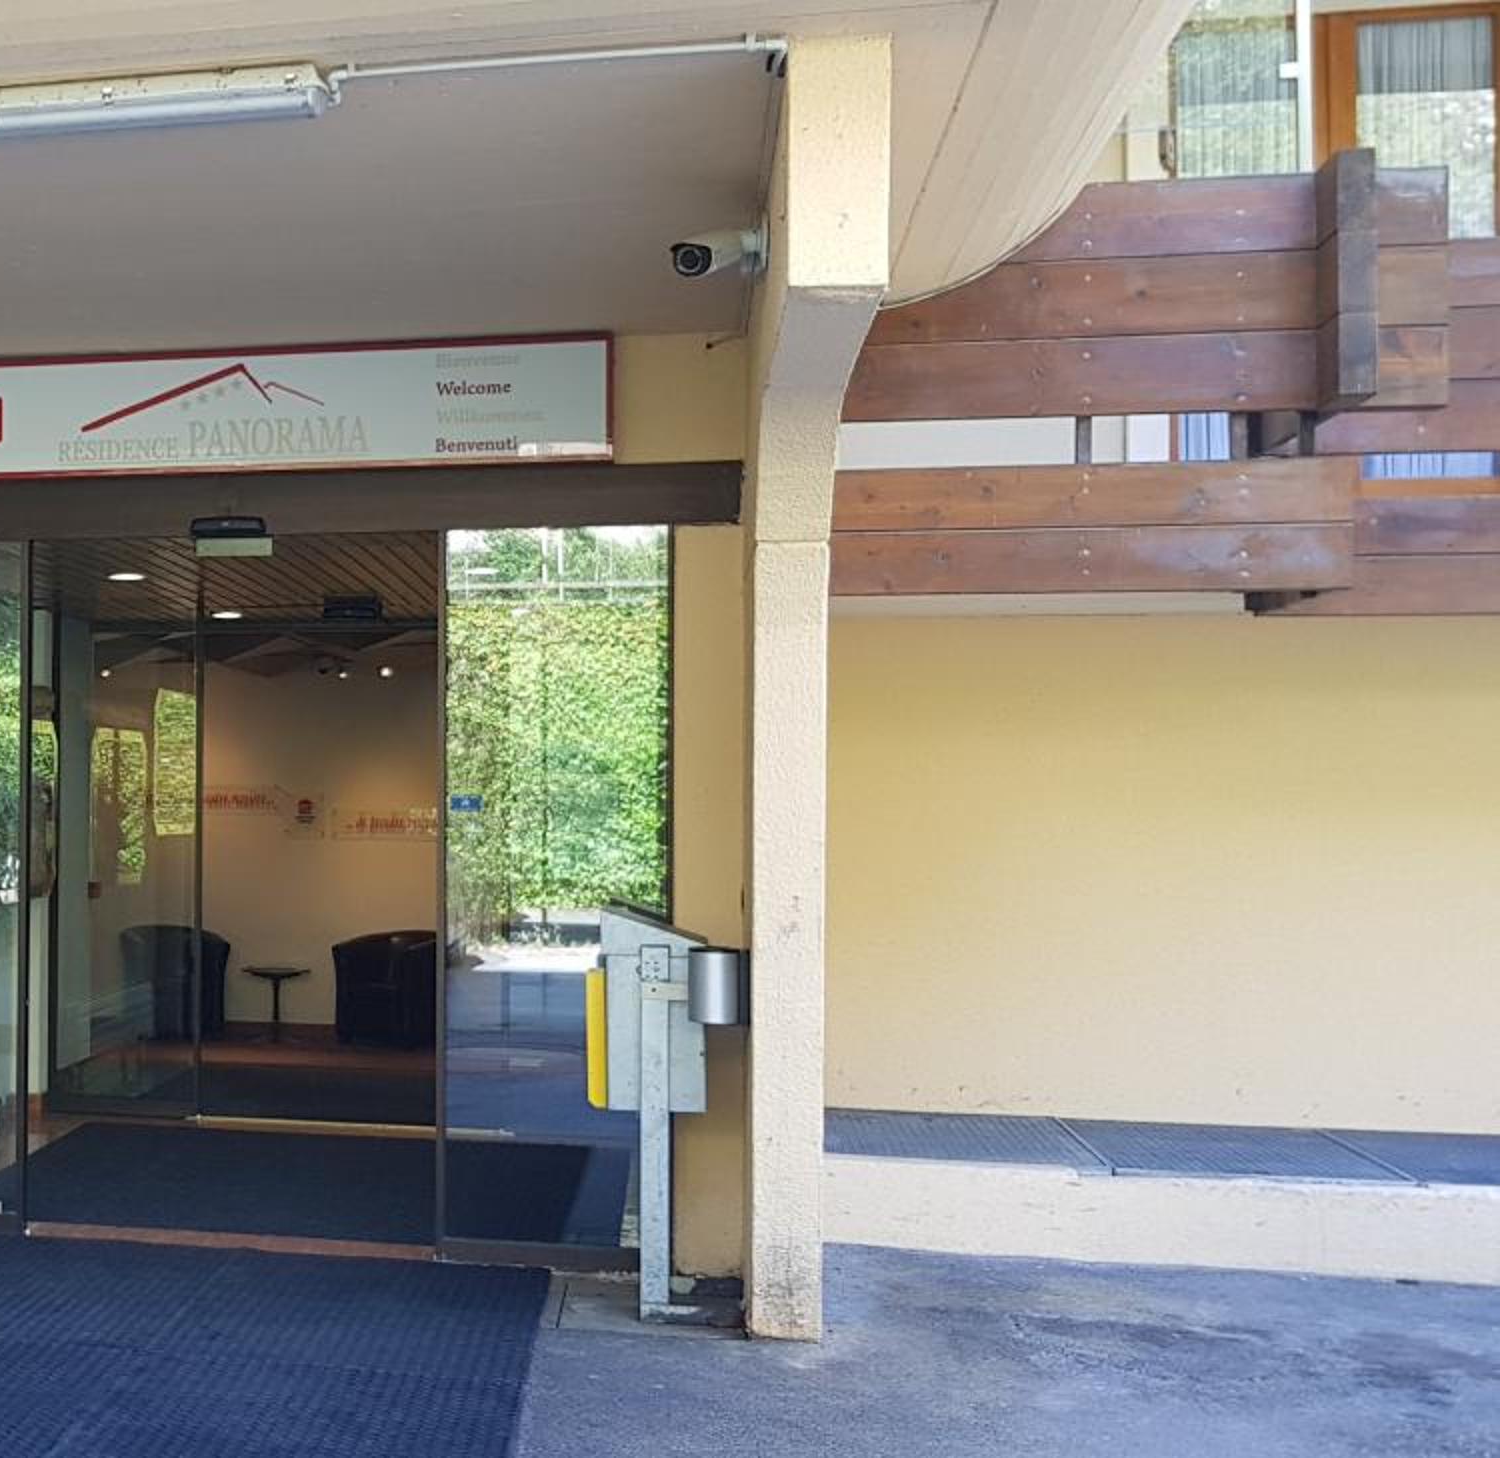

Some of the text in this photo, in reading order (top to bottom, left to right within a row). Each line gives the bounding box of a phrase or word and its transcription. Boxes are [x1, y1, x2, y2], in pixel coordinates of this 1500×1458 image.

[436, 380, 512, 396] Welcome
[58, 415, 371, 463] RÉSIDENCE PANORAMA
[436, 436, 517, 453] Benvenuti
